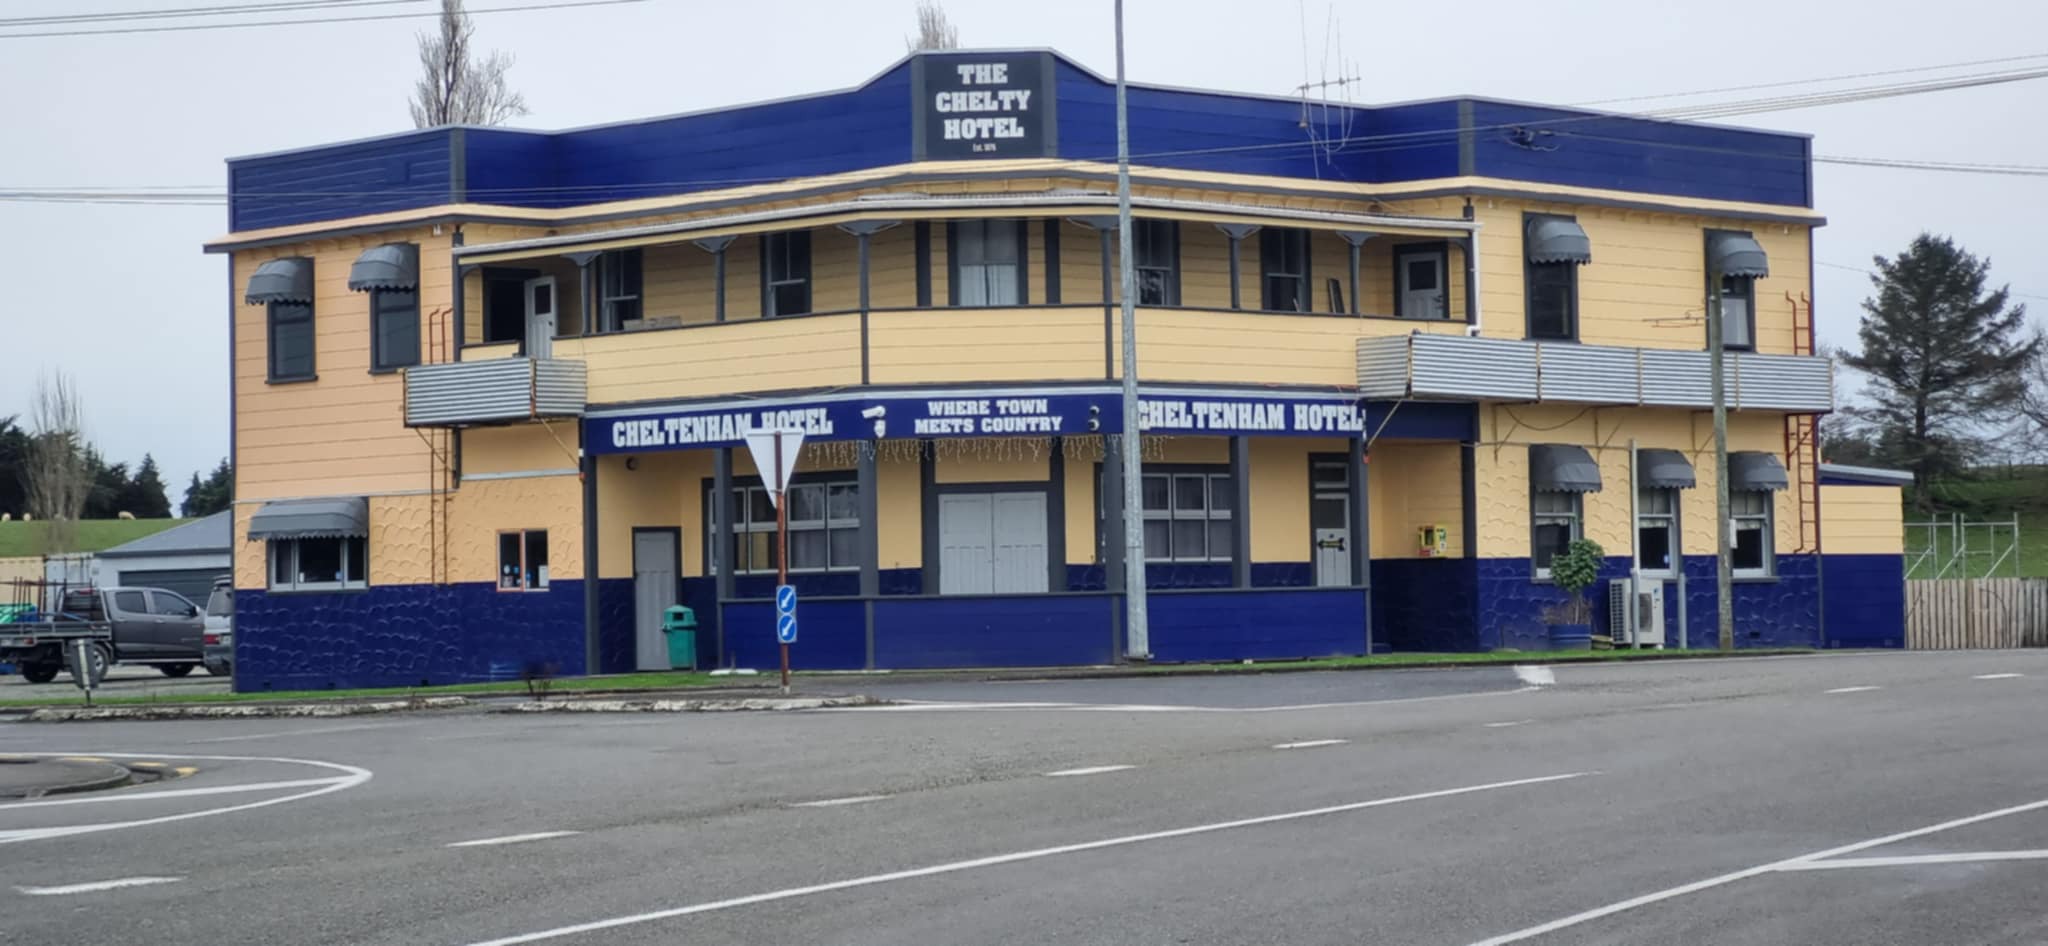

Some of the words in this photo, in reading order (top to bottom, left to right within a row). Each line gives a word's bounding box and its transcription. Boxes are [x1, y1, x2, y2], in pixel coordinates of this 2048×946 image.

[957, 63, 1008, 84] THE
[935, 90, 1031, 112] CHELTY
[944, 117, 1025, 139] HOTEL
[928, 400, 990, 416] WHERE
[996, 399, 1048, 414] TOWN
[1138, 400, 1285, 430] CHELTENHAM
[1294, 404, 1363, 431] HOTEL
[612, 413, 752, 447] CHELTENHAM
[761, 408, 833, 435] HOTEL
[914, 418, 974, 434] MEETS
[981, 416, 1063, 433] COUNTRY
